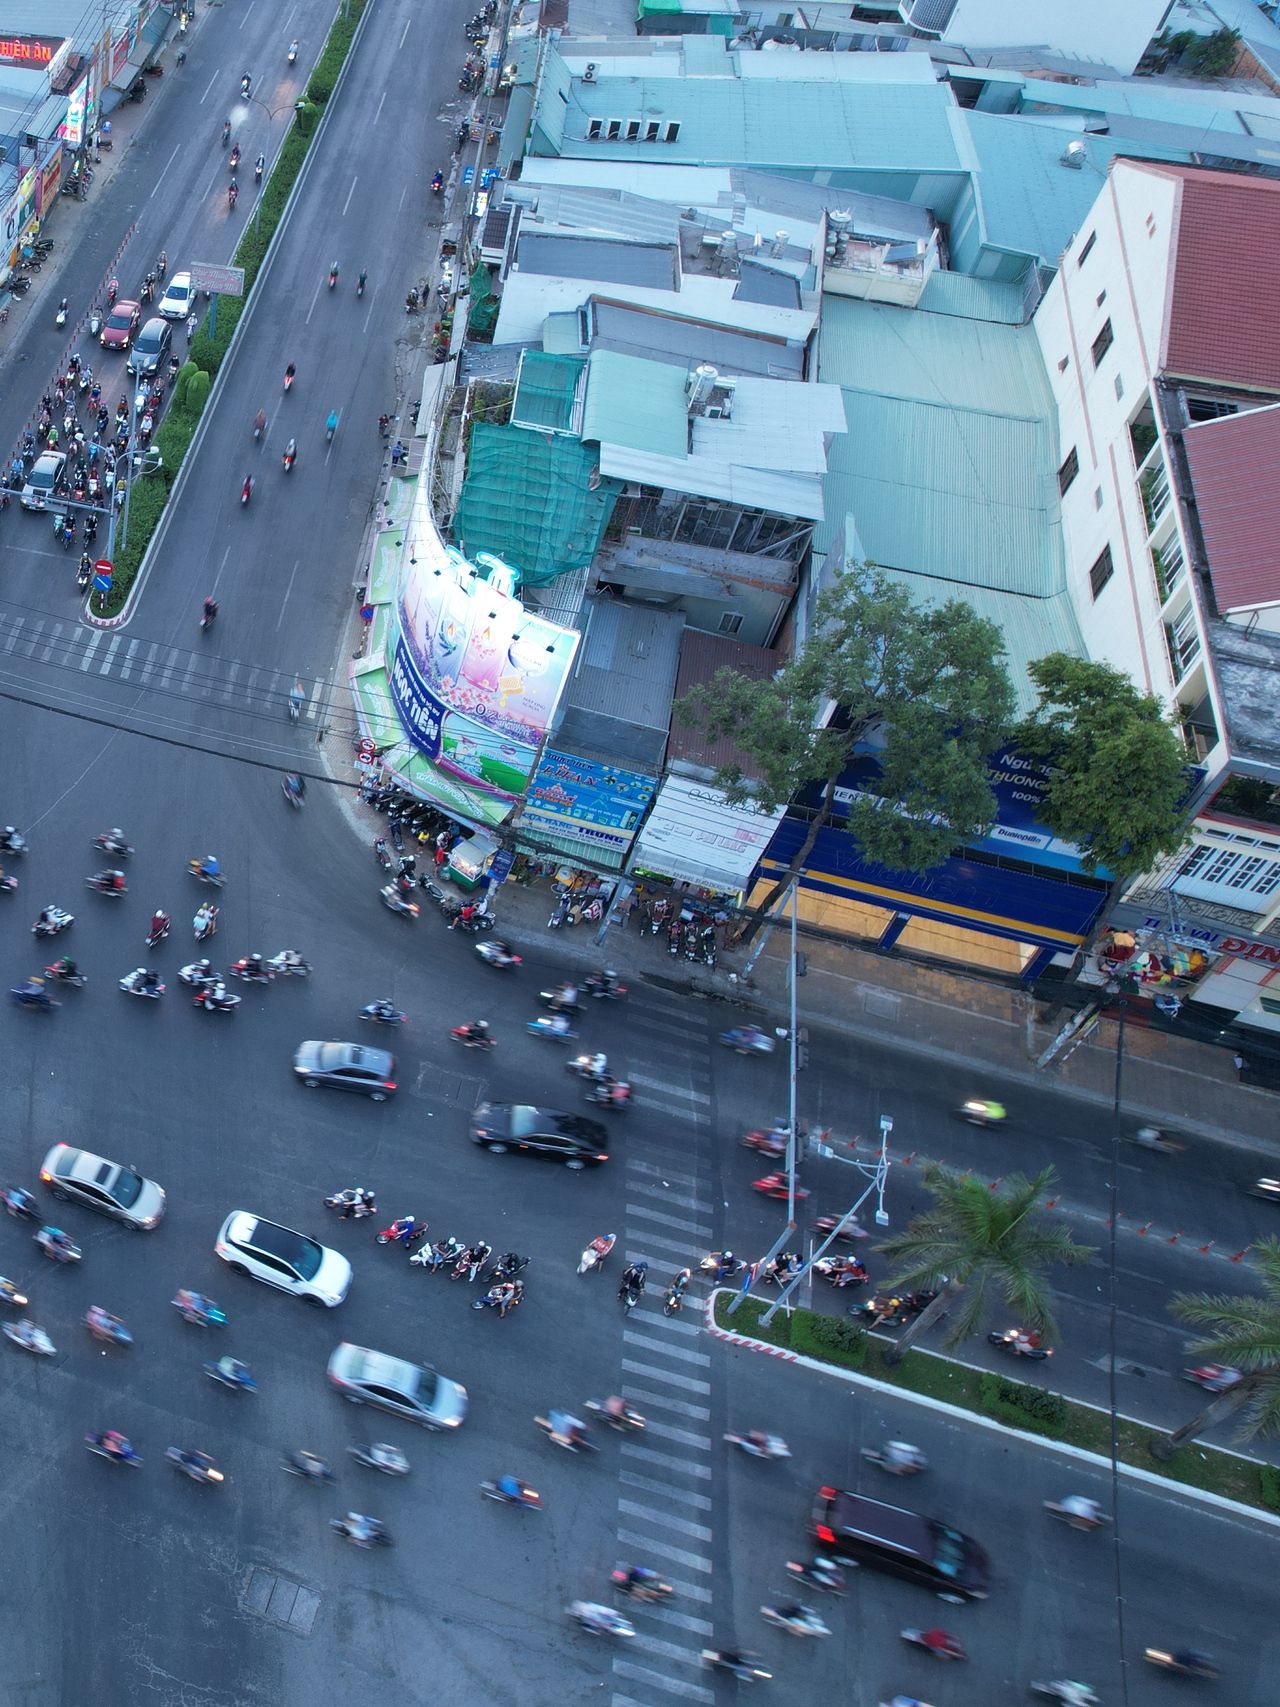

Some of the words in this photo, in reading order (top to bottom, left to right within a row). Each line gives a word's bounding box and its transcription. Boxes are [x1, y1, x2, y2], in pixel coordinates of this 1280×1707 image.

[32, 41, 52, 62] ÂN
[393, 657, 412, 708] NGỌC
[410, 697, 438, 741] TIÊN
[540, 765, 600, 787] LIFAN
[1011, 791, 1041, 804] 100%
[578, 827, 623, 843] TRUNG
[997, 828, 1042, 844] Dunlopillo
